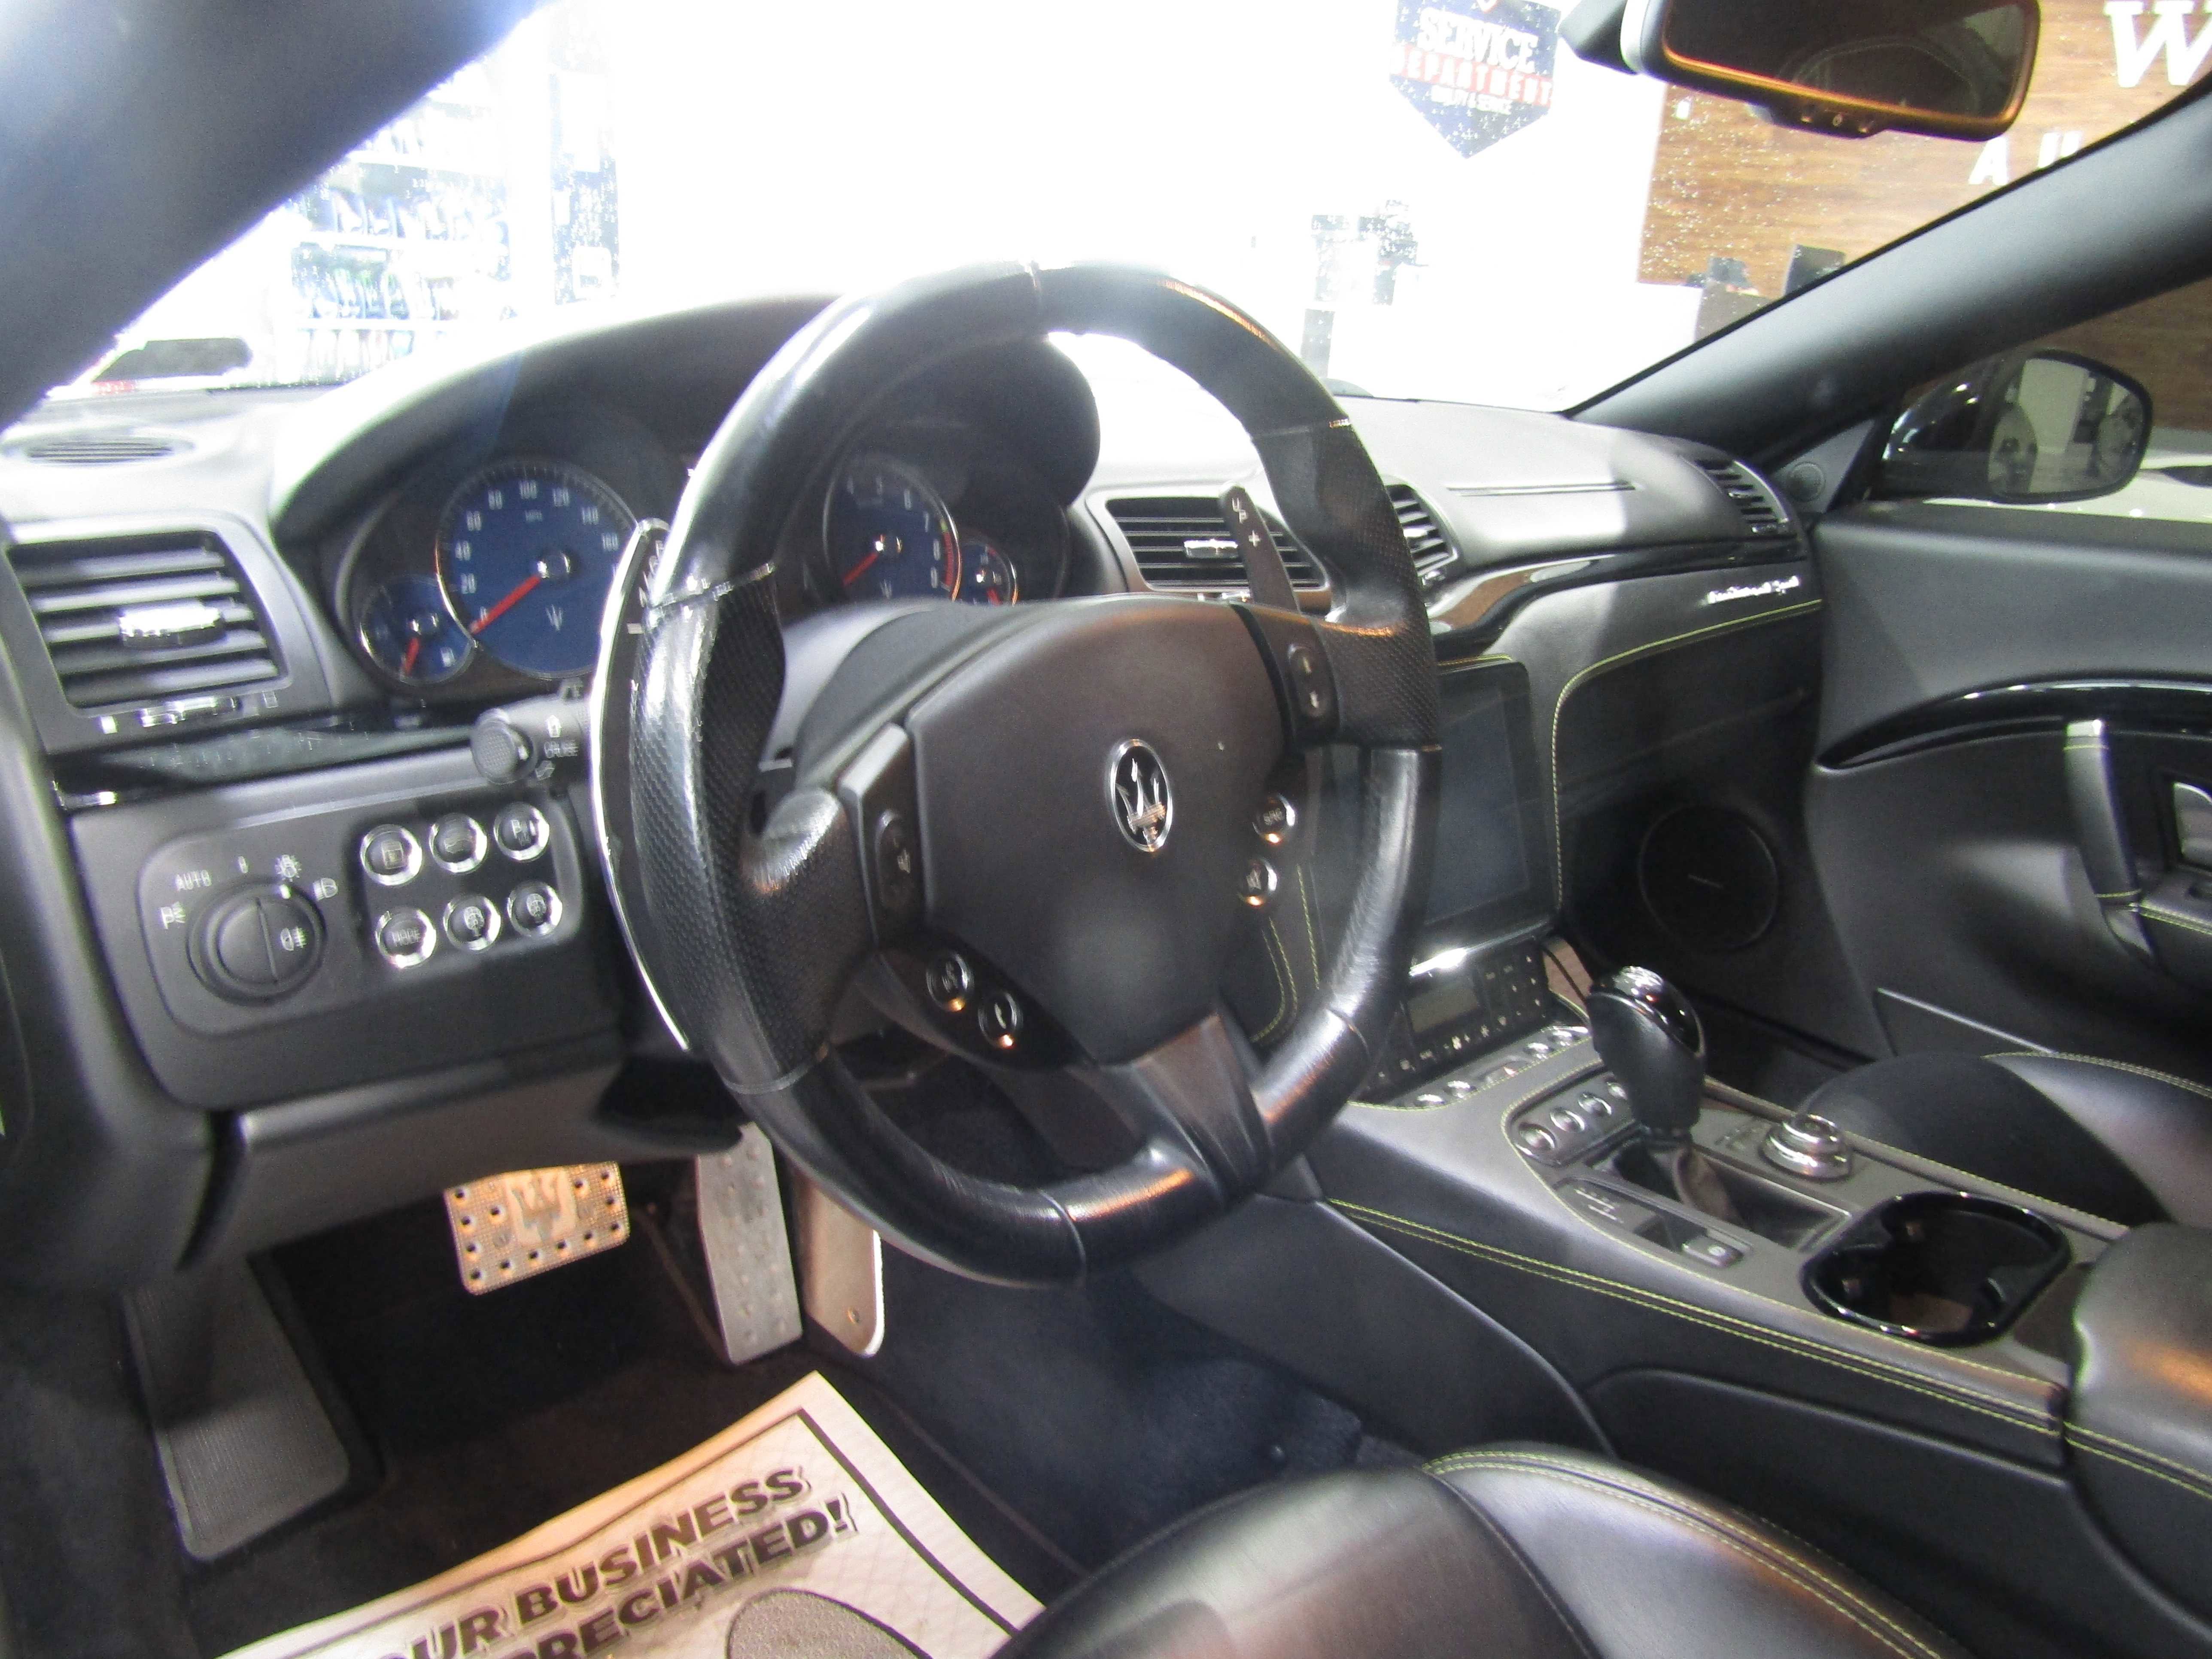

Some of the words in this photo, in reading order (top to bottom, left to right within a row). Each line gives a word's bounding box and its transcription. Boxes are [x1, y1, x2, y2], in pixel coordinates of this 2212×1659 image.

[1417, 7, 1539, 74] SERVICE
[1390, 43, 1553, 107] DEPARTMENT
[175, 870, 212, 891] AUTO
[380, 1607, 504, 1659] UR
[516, 1468, 806, 1624] BUSINESS
[504, 1499, 850, 1659] RECIATED!
